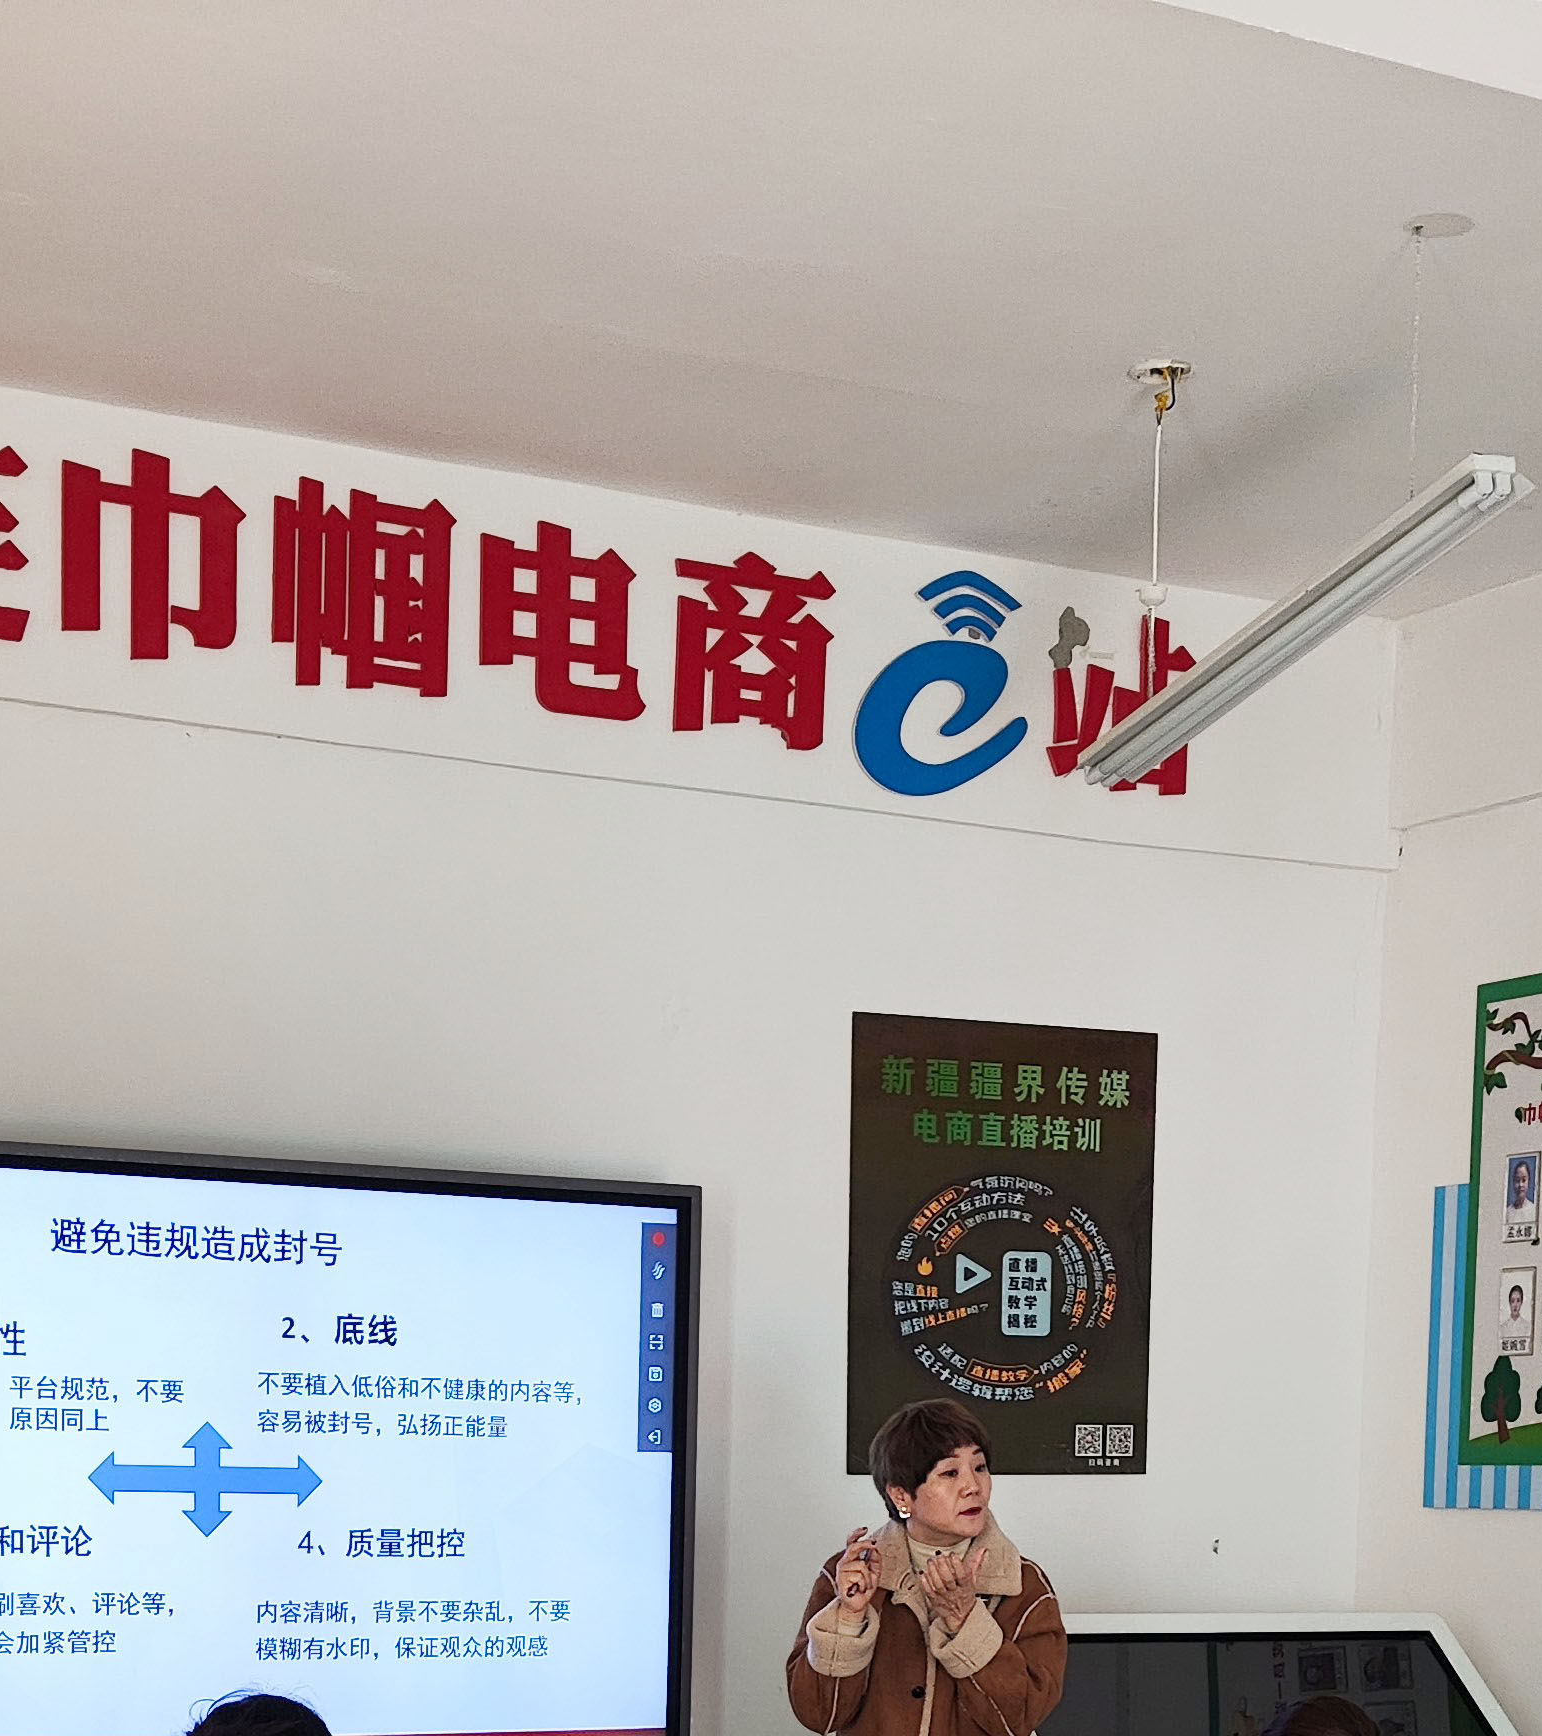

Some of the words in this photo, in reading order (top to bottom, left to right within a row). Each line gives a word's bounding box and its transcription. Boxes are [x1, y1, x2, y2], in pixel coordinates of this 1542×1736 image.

[880, 1055, 1131, 1108] 新疆疆界传媒
[912, 1108, 1104, 1153] 电商直播培训
[49, 1215, 345, 1268] 避免违规造成封号
[1008, 1257, 1038, 1273] 直播
[1007, 1276, 1048, 1292] 互动式
[1007, 1295, 1038, 1310] 教学
[280, 1311, 399, 1349] 2、底线
[1006, 1313, 1038, 1330] 揭秘
[256, 1369, 584, 1408] 不要植入低俗和不健康的内容等，
[256, 1407, 510, 1441] 容易被封号，弘扬正能量
[296, 1526, 467, 1562] 4、质量把控
[254, 1597, 572, 1627] 内容清晰，背景不要杂乱，不要
[254, 1633, 550, 1664] 模糊有水印，保证观众的观感
